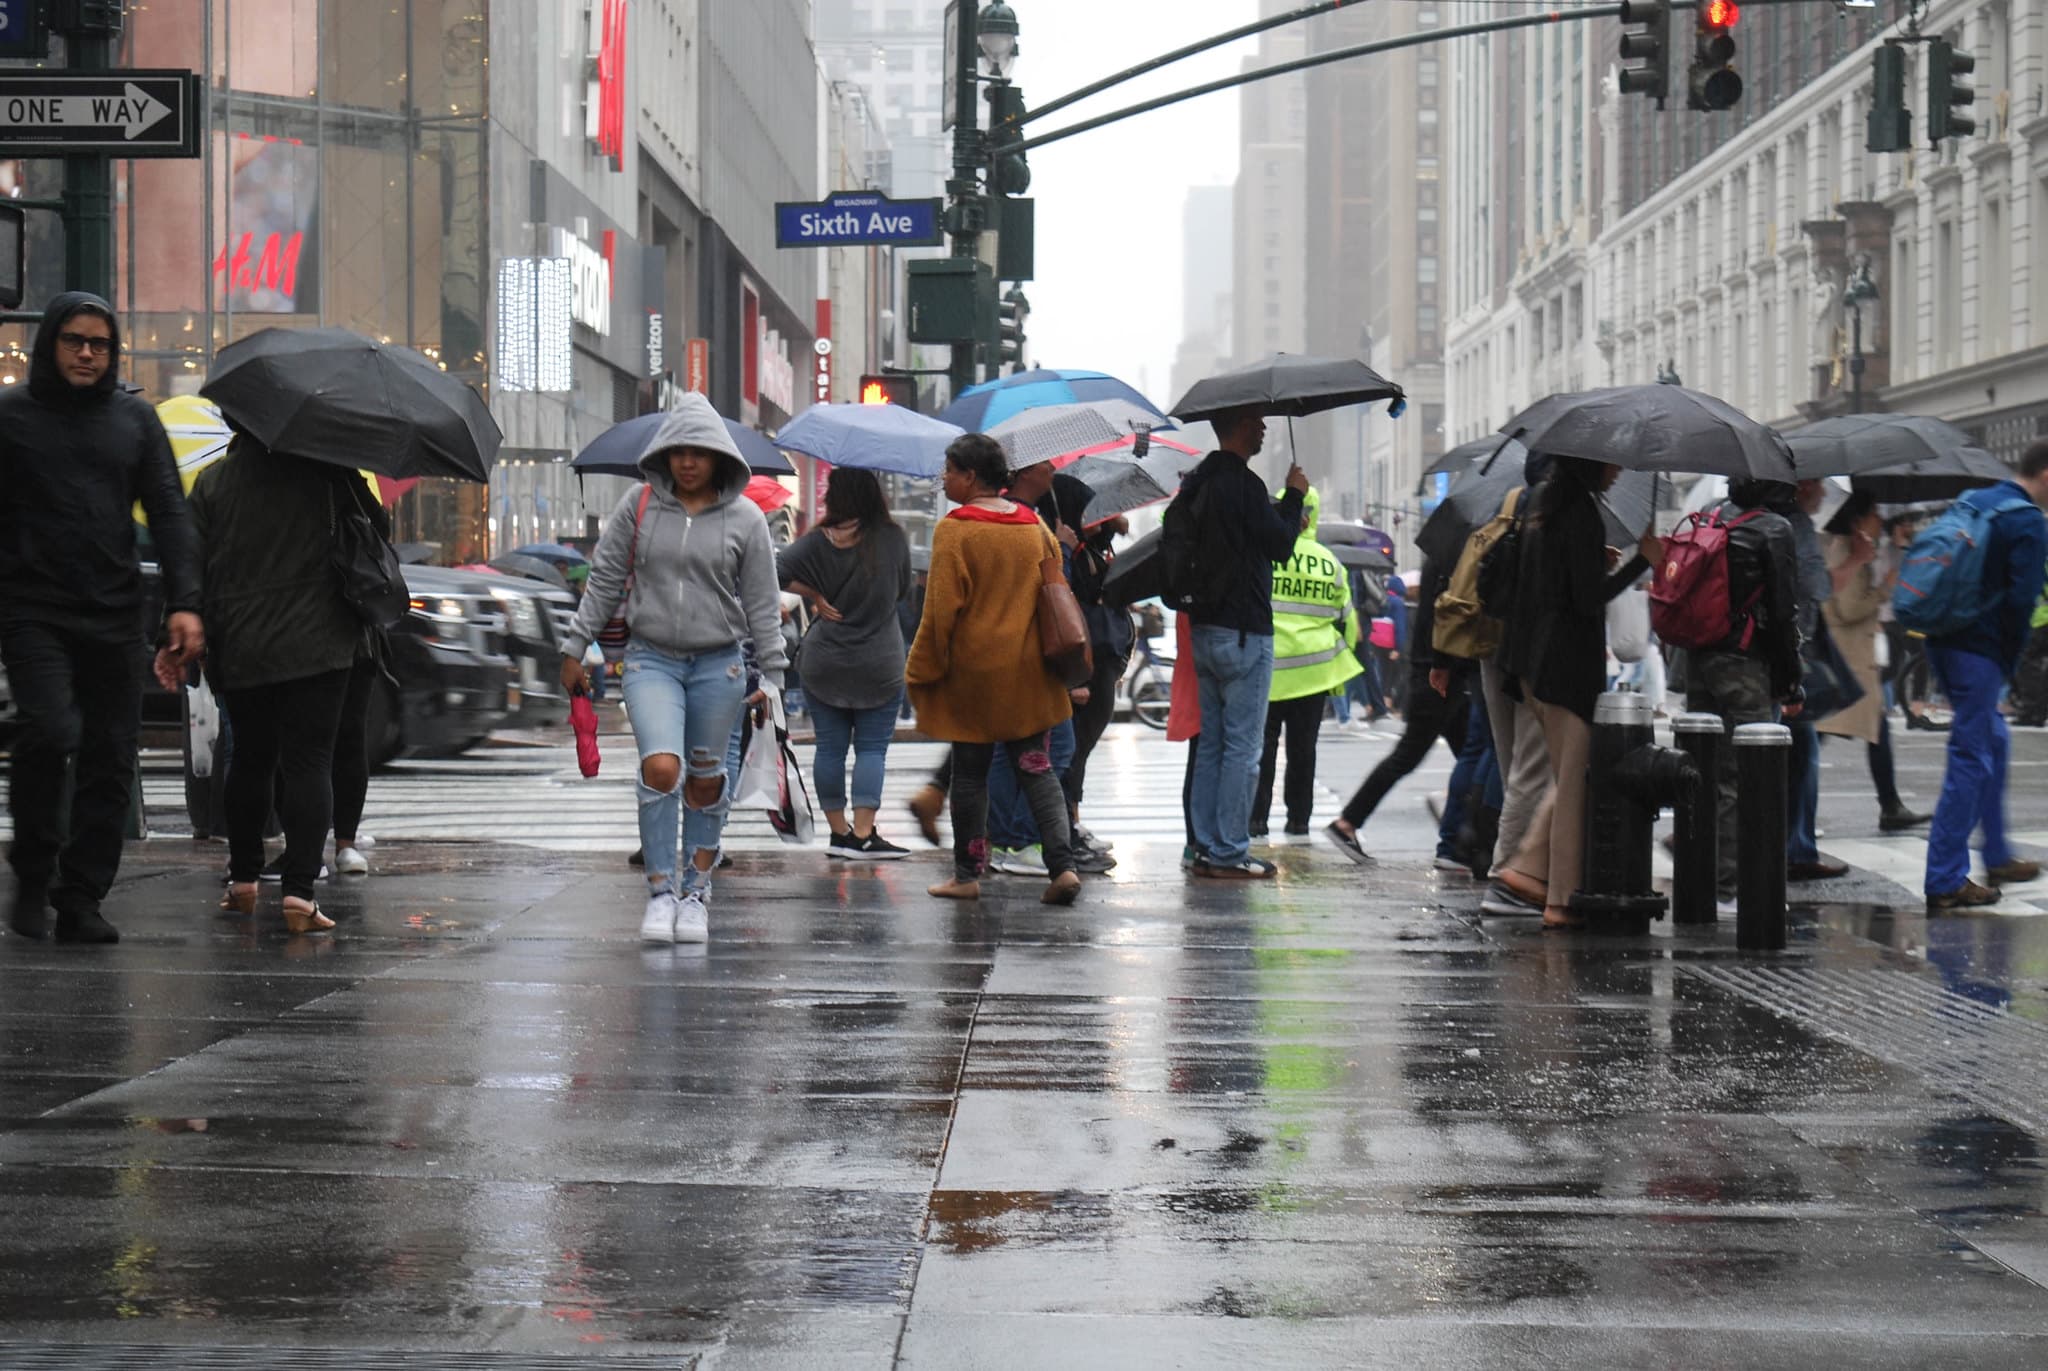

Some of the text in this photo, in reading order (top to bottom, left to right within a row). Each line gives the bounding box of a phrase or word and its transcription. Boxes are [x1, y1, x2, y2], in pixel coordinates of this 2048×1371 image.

[8, 98, 149, 123] ONE WAY
[800, 212, 912, 236] Sixth Ave
[213, 231, 304, 297] H&M
[646, 314, 662, 376] verizon
[1272, 577, 1336, 601] TRAFFIC
